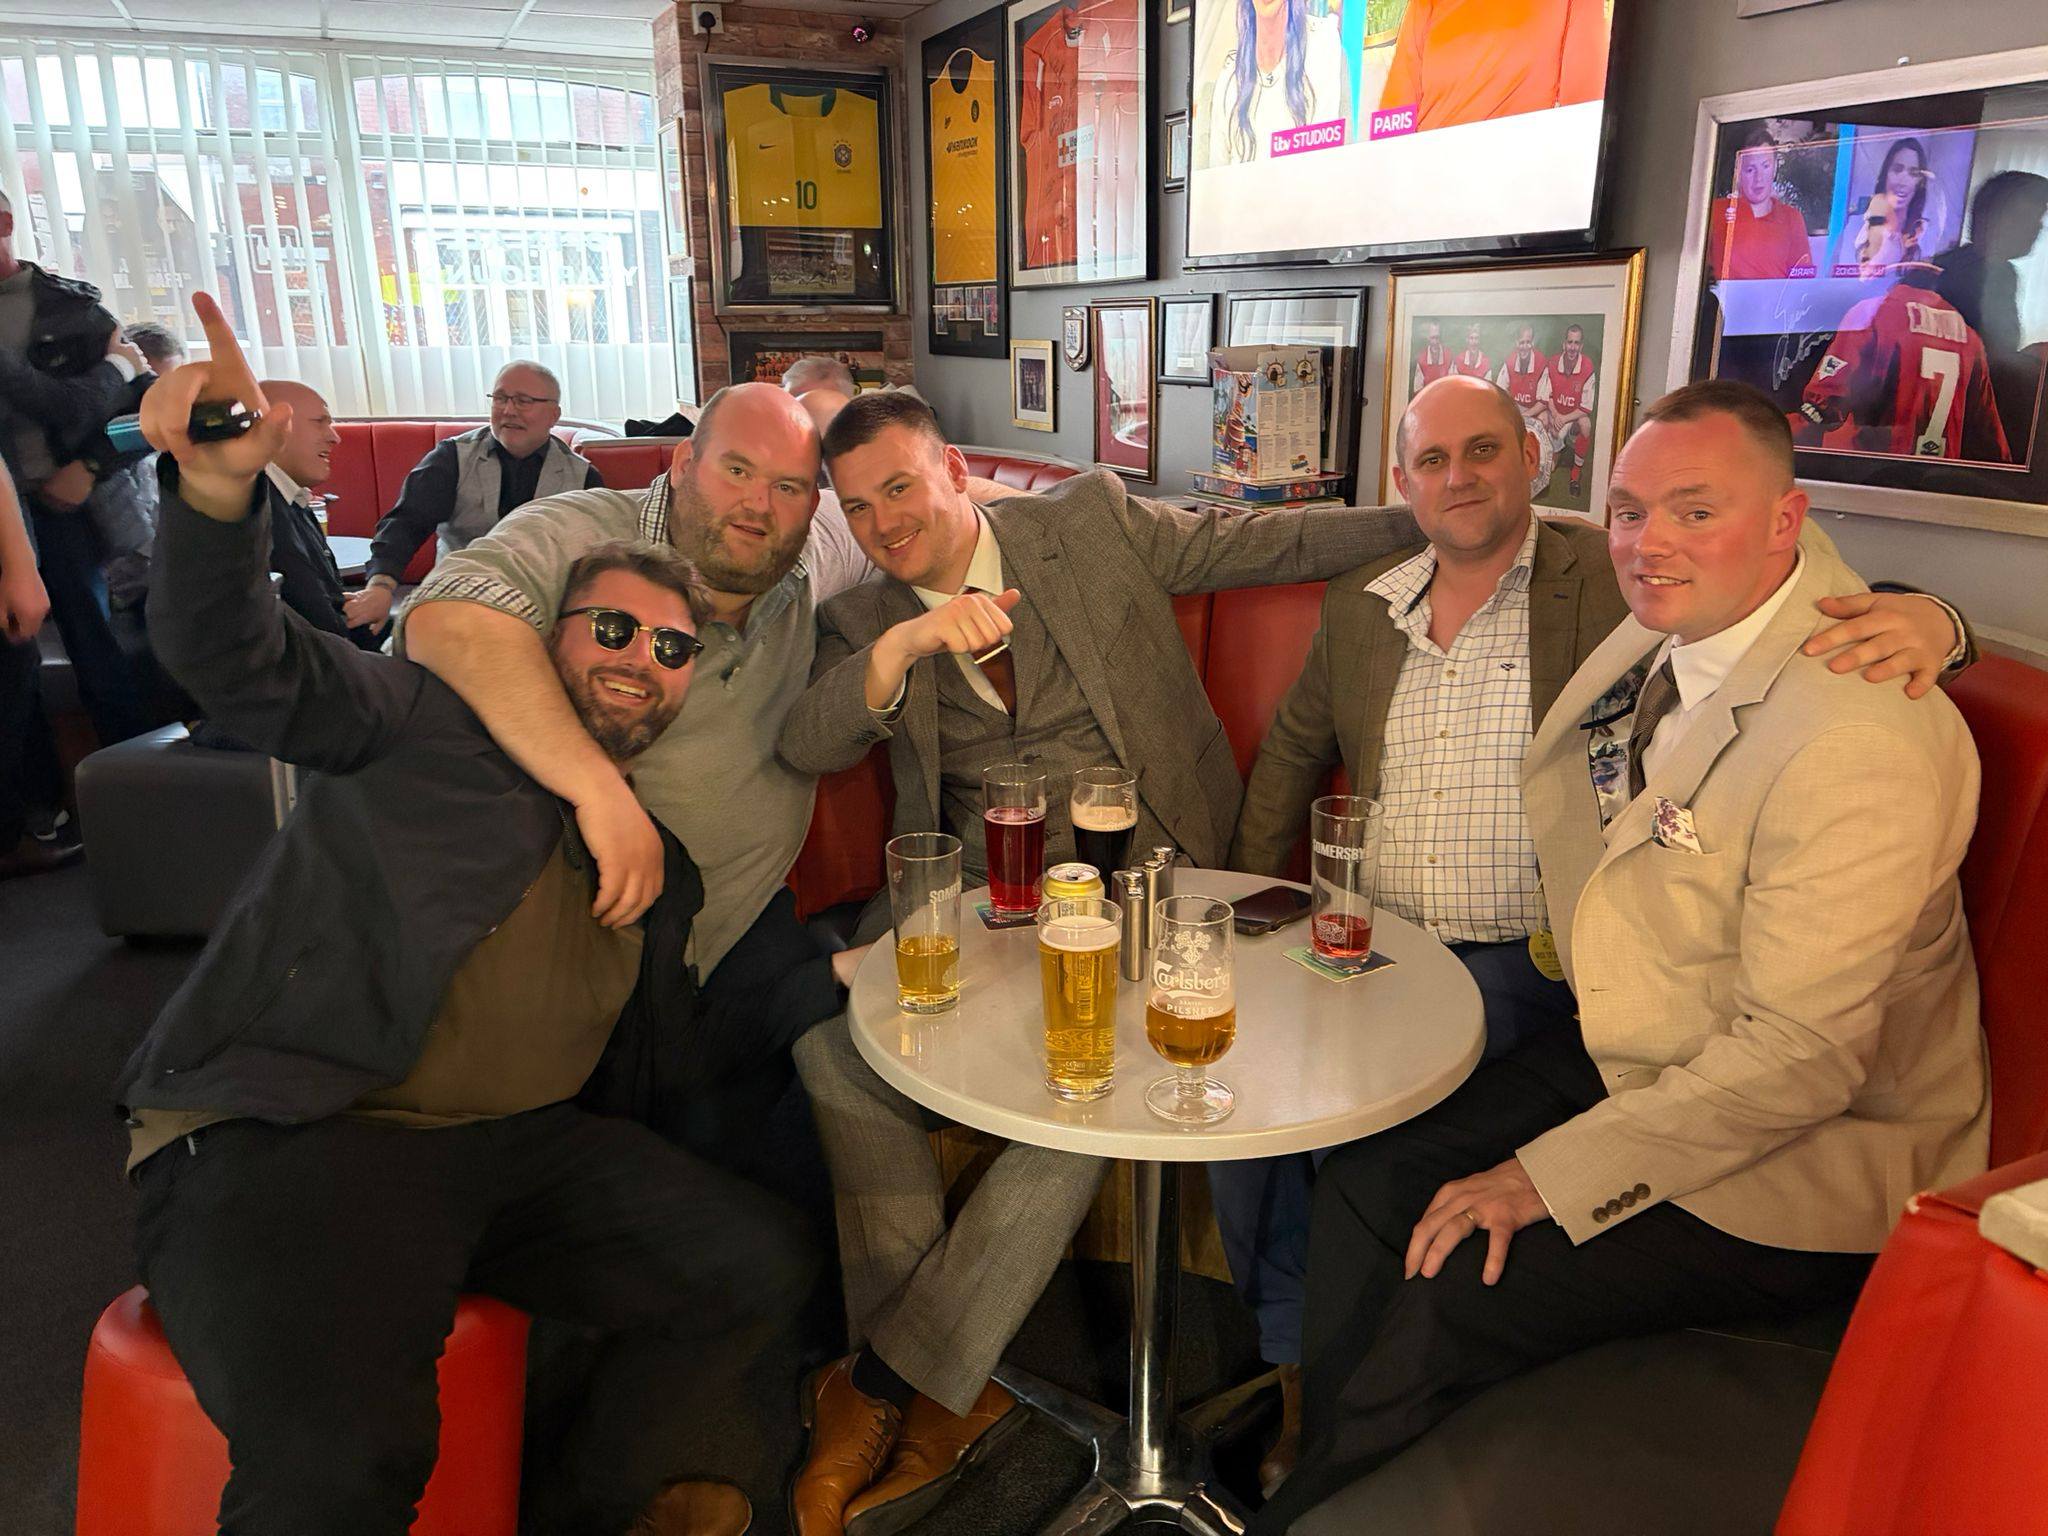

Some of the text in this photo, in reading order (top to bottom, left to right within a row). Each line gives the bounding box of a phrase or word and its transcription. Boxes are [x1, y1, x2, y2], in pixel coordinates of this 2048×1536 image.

[1374, 111, 1413, 134] PARIS
[1293, 125, 1342, 149] STUDIOS
[796, 180, 818, 210] 10
[1515, 393, 1532, 403] JVC
[1557, 395, 1575, 406] JVC
[1917, 347, 1960, 456] 7
[1153, 960, 1231, 991] Carlsberg
[1166, 1003, 1215, 1016] PILSNER
